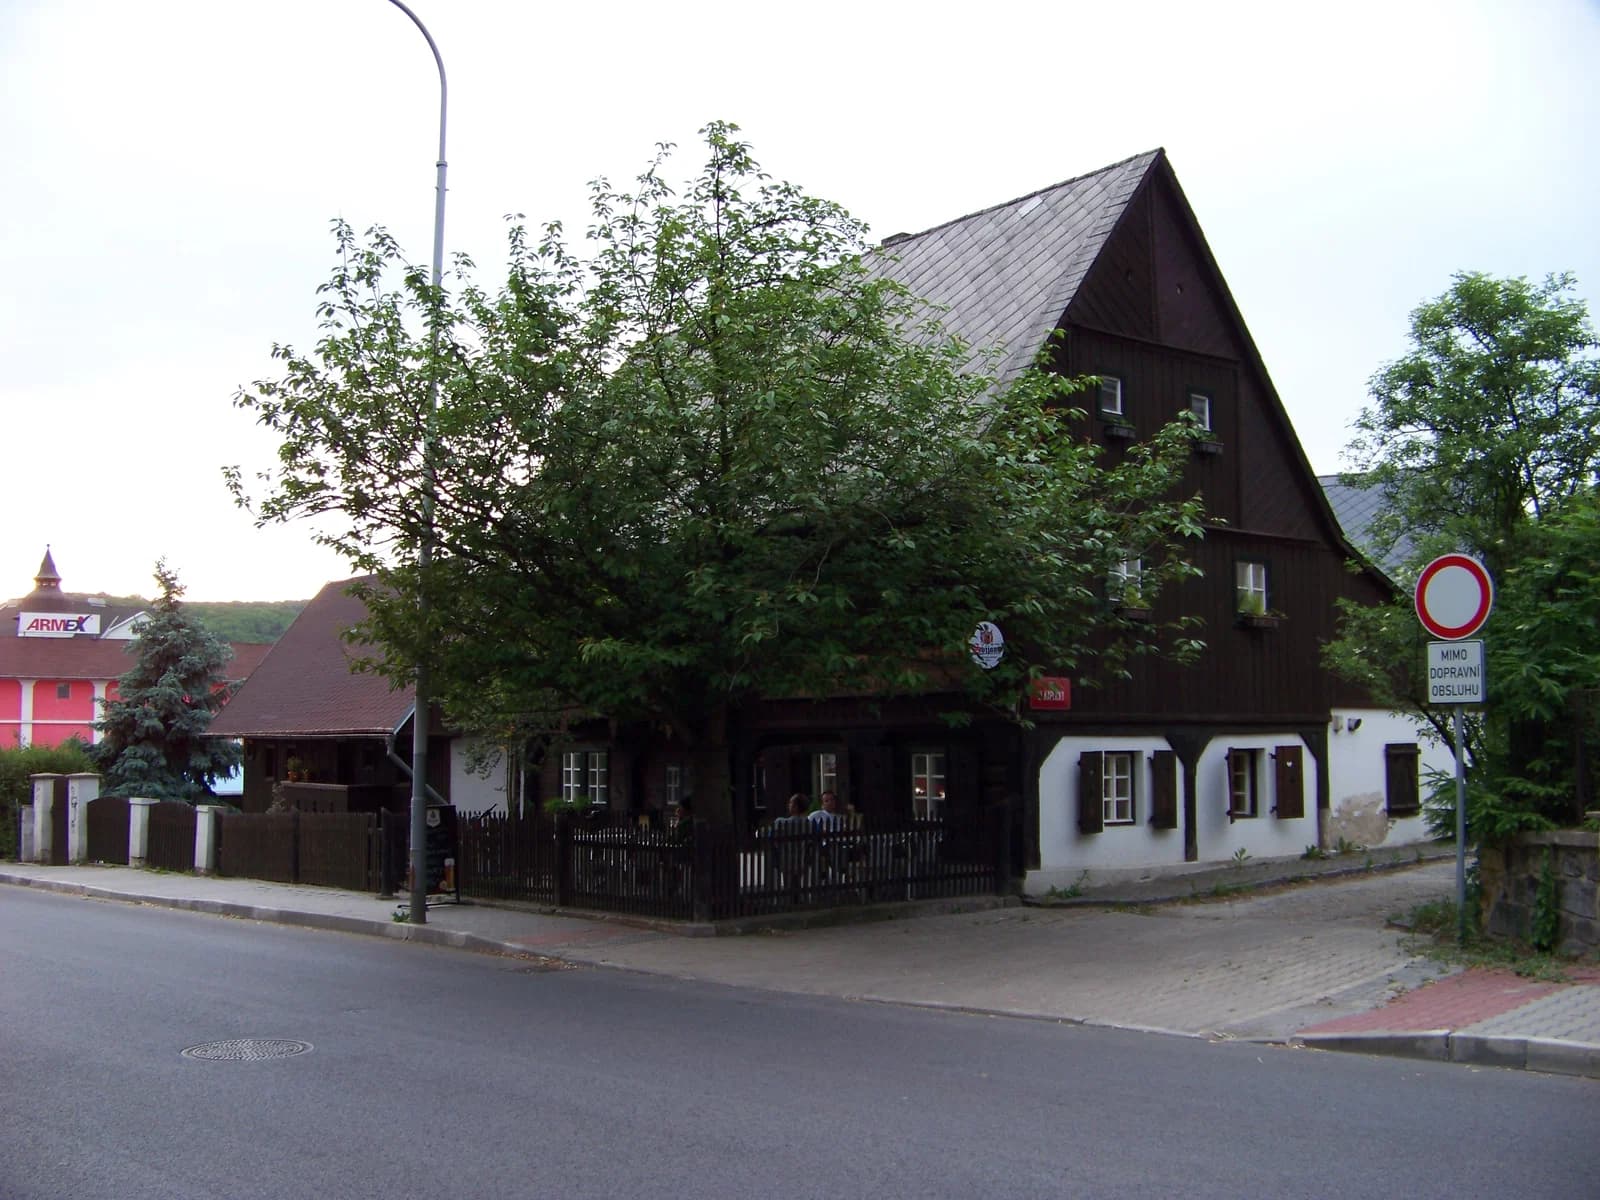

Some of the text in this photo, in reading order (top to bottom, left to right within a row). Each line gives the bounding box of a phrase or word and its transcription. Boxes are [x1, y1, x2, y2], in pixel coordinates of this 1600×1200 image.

[27, 615, 92, 632] ARMEX
[1441, 648, 1468, 661] MIMO
[1430, 663, 1480, 679] DOPRAVNÍ
[1431, 684, 1479, 696] OBSLUHU
